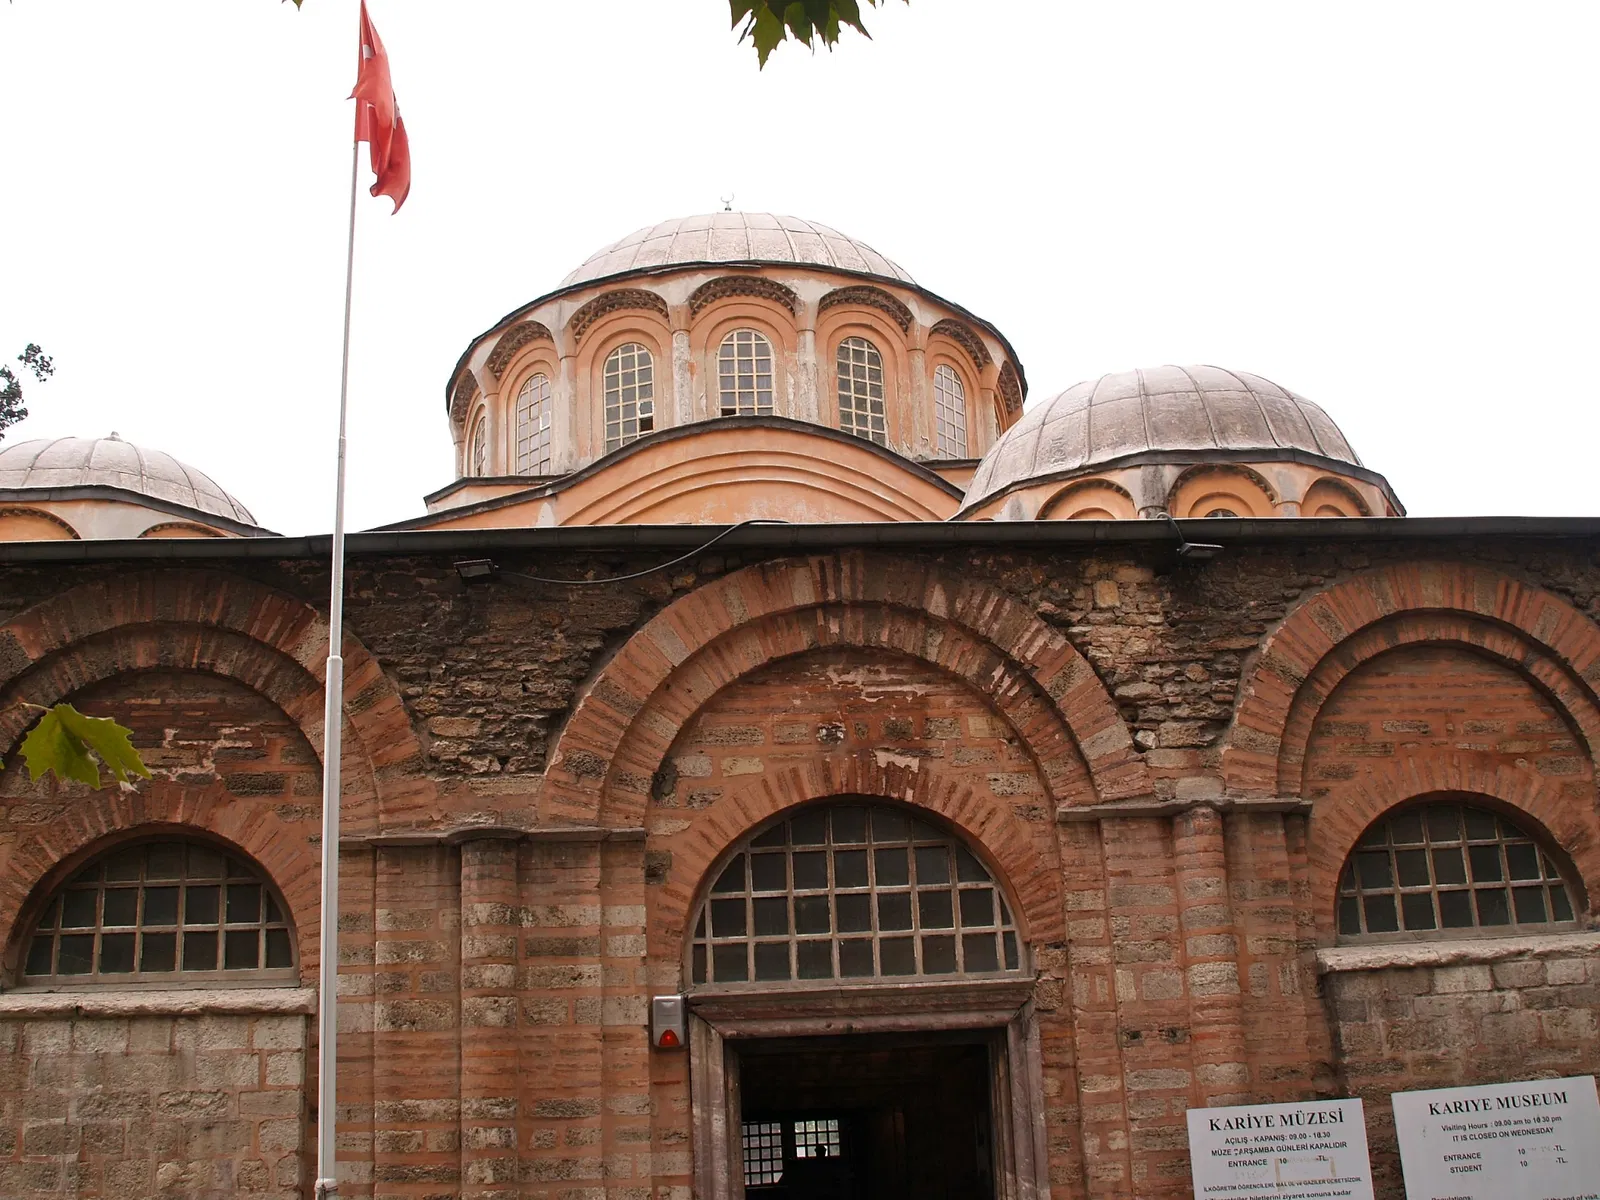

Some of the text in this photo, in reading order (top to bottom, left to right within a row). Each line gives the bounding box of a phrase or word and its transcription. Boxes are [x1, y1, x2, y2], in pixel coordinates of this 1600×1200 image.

[1428, 1091, 1568, 1115] KARIYE MUSEUM
[1209, 1108, 1344, 1131] KARİYE MÜZESİ
[1441, 1123, 1466, 1131] Visiting
[1468, 1122, 1488, 1130] Hours
[1289, 1133, 1307, 1141] 09.00
[1460, 1134, 1468, 1142] IS
[1469, 1132, 1497, 1141] CLOSED
[1498, 1130, 1510, 1138] ON
[1510, 1126, 1554, 1137] WEDNESDAY
[1212, 1148, 1231, 1157] MÜZE
[1276, 1143, 1309, 1153] GÜNLERİ
[1310, 1141, 1348, 1150] KAPALIDIR
[1444, 1152, 1482, 1162] ENTRANCE
[1228, 1158, 1268, 1168] ENTRANCE
[1450, 1164, 1482, 1174] STUDENT
[1282, 1192, 1305, 1200] ziyaret
